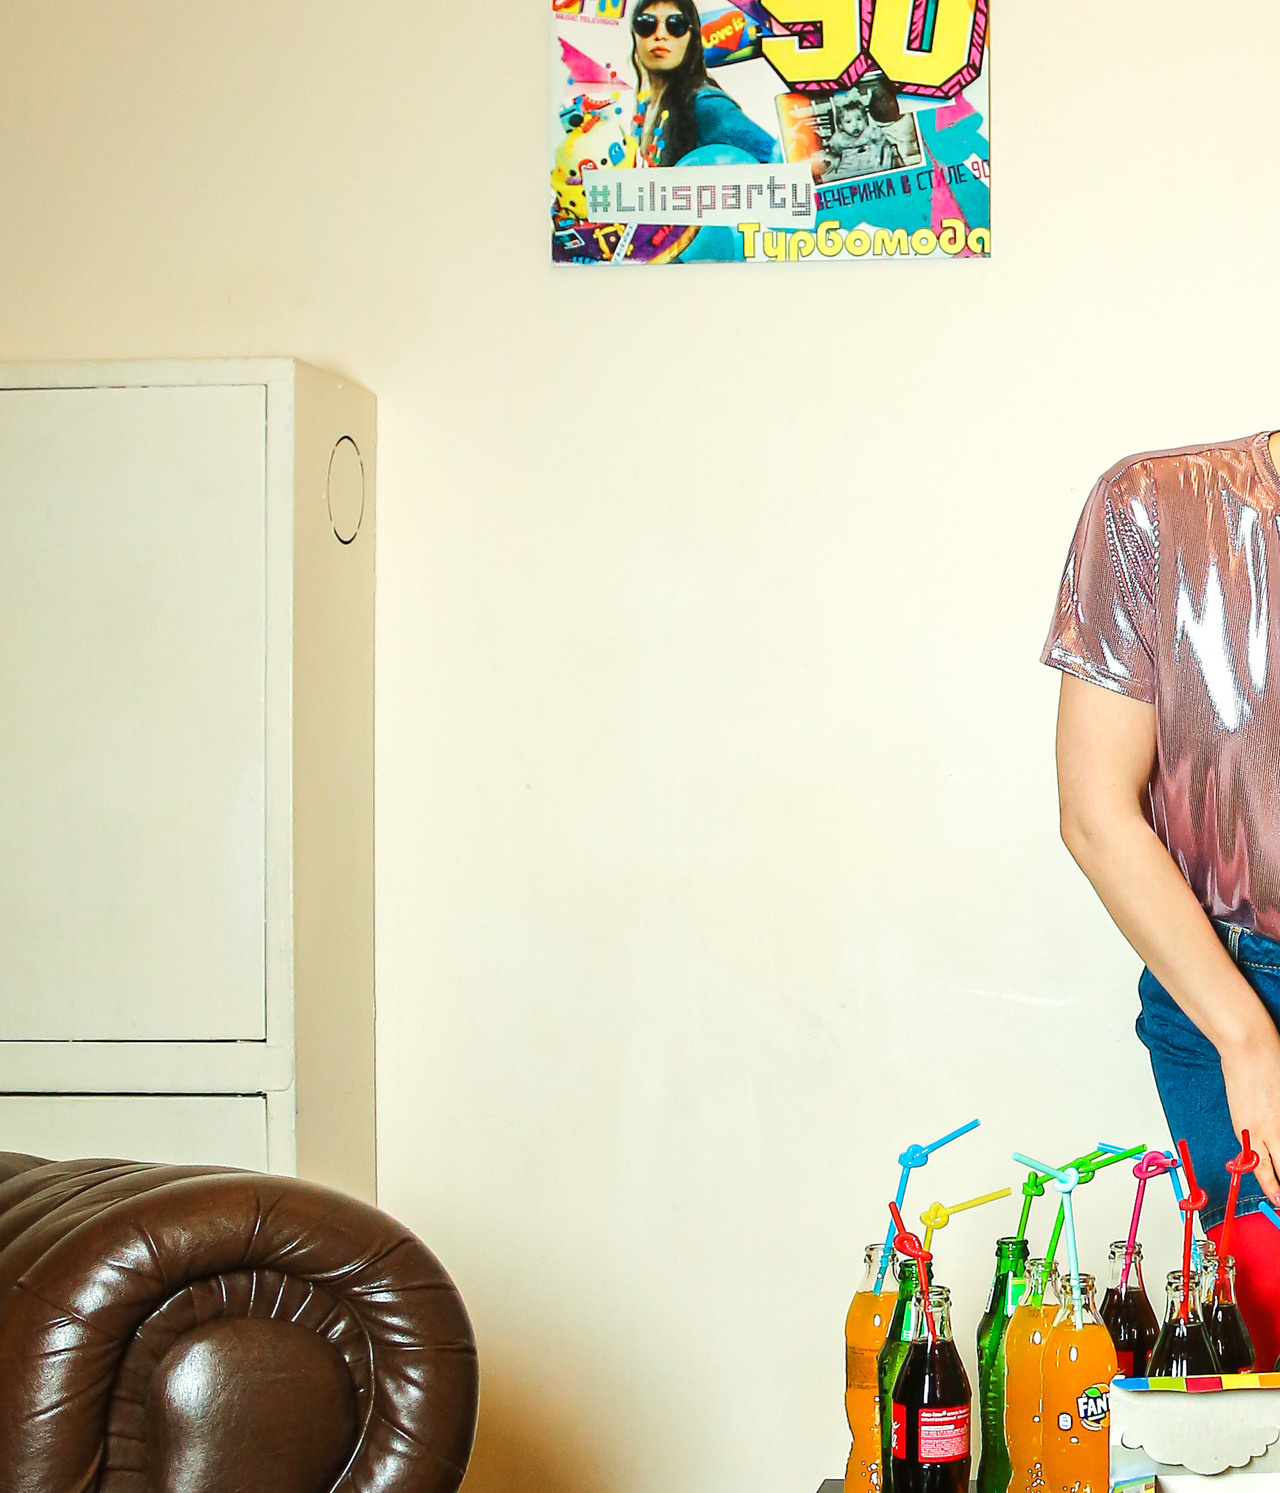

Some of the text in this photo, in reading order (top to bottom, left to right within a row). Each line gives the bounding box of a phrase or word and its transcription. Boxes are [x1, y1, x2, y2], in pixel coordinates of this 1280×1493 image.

[701, 25, 734, 49] Love
[588, 176, 812, 218] #Lilisparty
[814, 177, 896, 211] ВЕЧЕРИНКА
[738, 217, 991, 262] Турбомода
[1077, 1393, 1110, 1418] FAN
